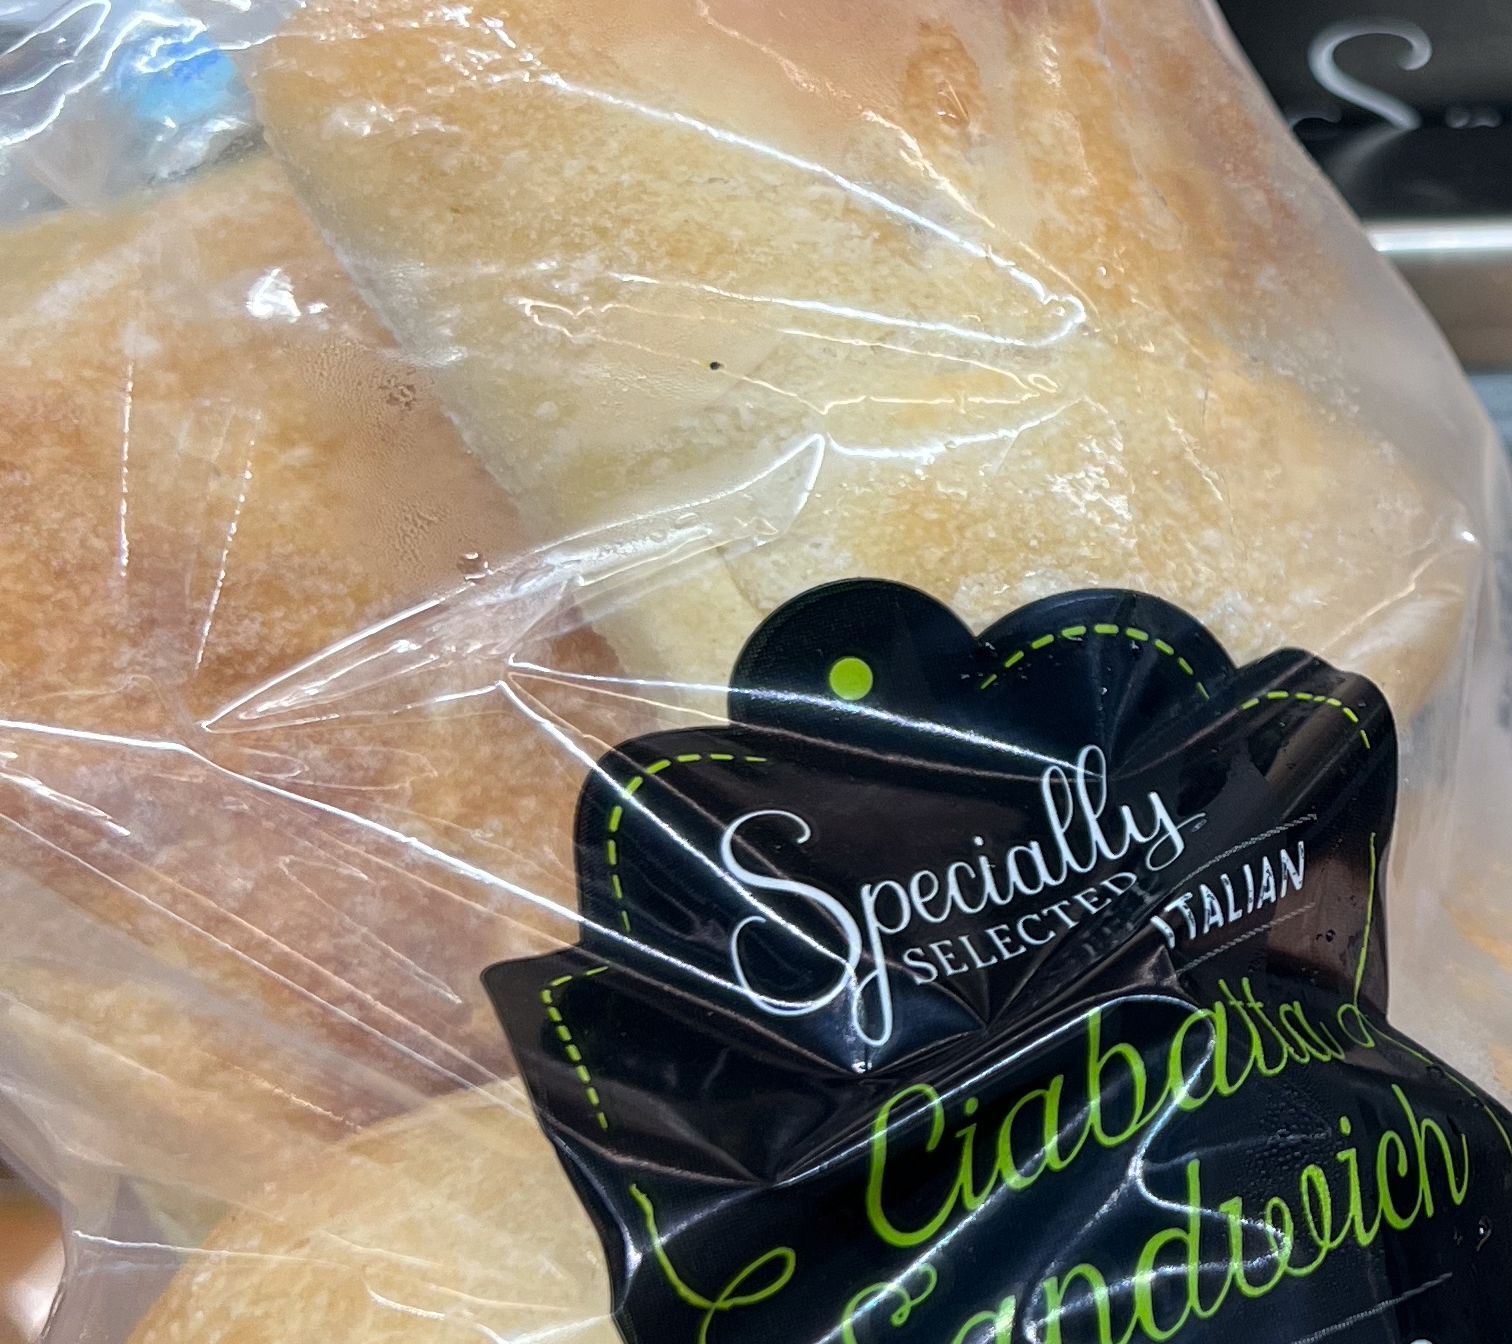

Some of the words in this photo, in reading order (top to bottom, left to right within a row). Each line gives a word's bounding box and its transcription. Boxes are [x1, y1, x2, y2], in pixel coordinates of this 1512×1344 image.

[720, 744, 1206, 1048] Specially
[893, 870, 1139, 986] SELECTED
[1150, 840, 1308, 951] ITALIAN
[866, 976, 1352, 1248] Ciabatta
